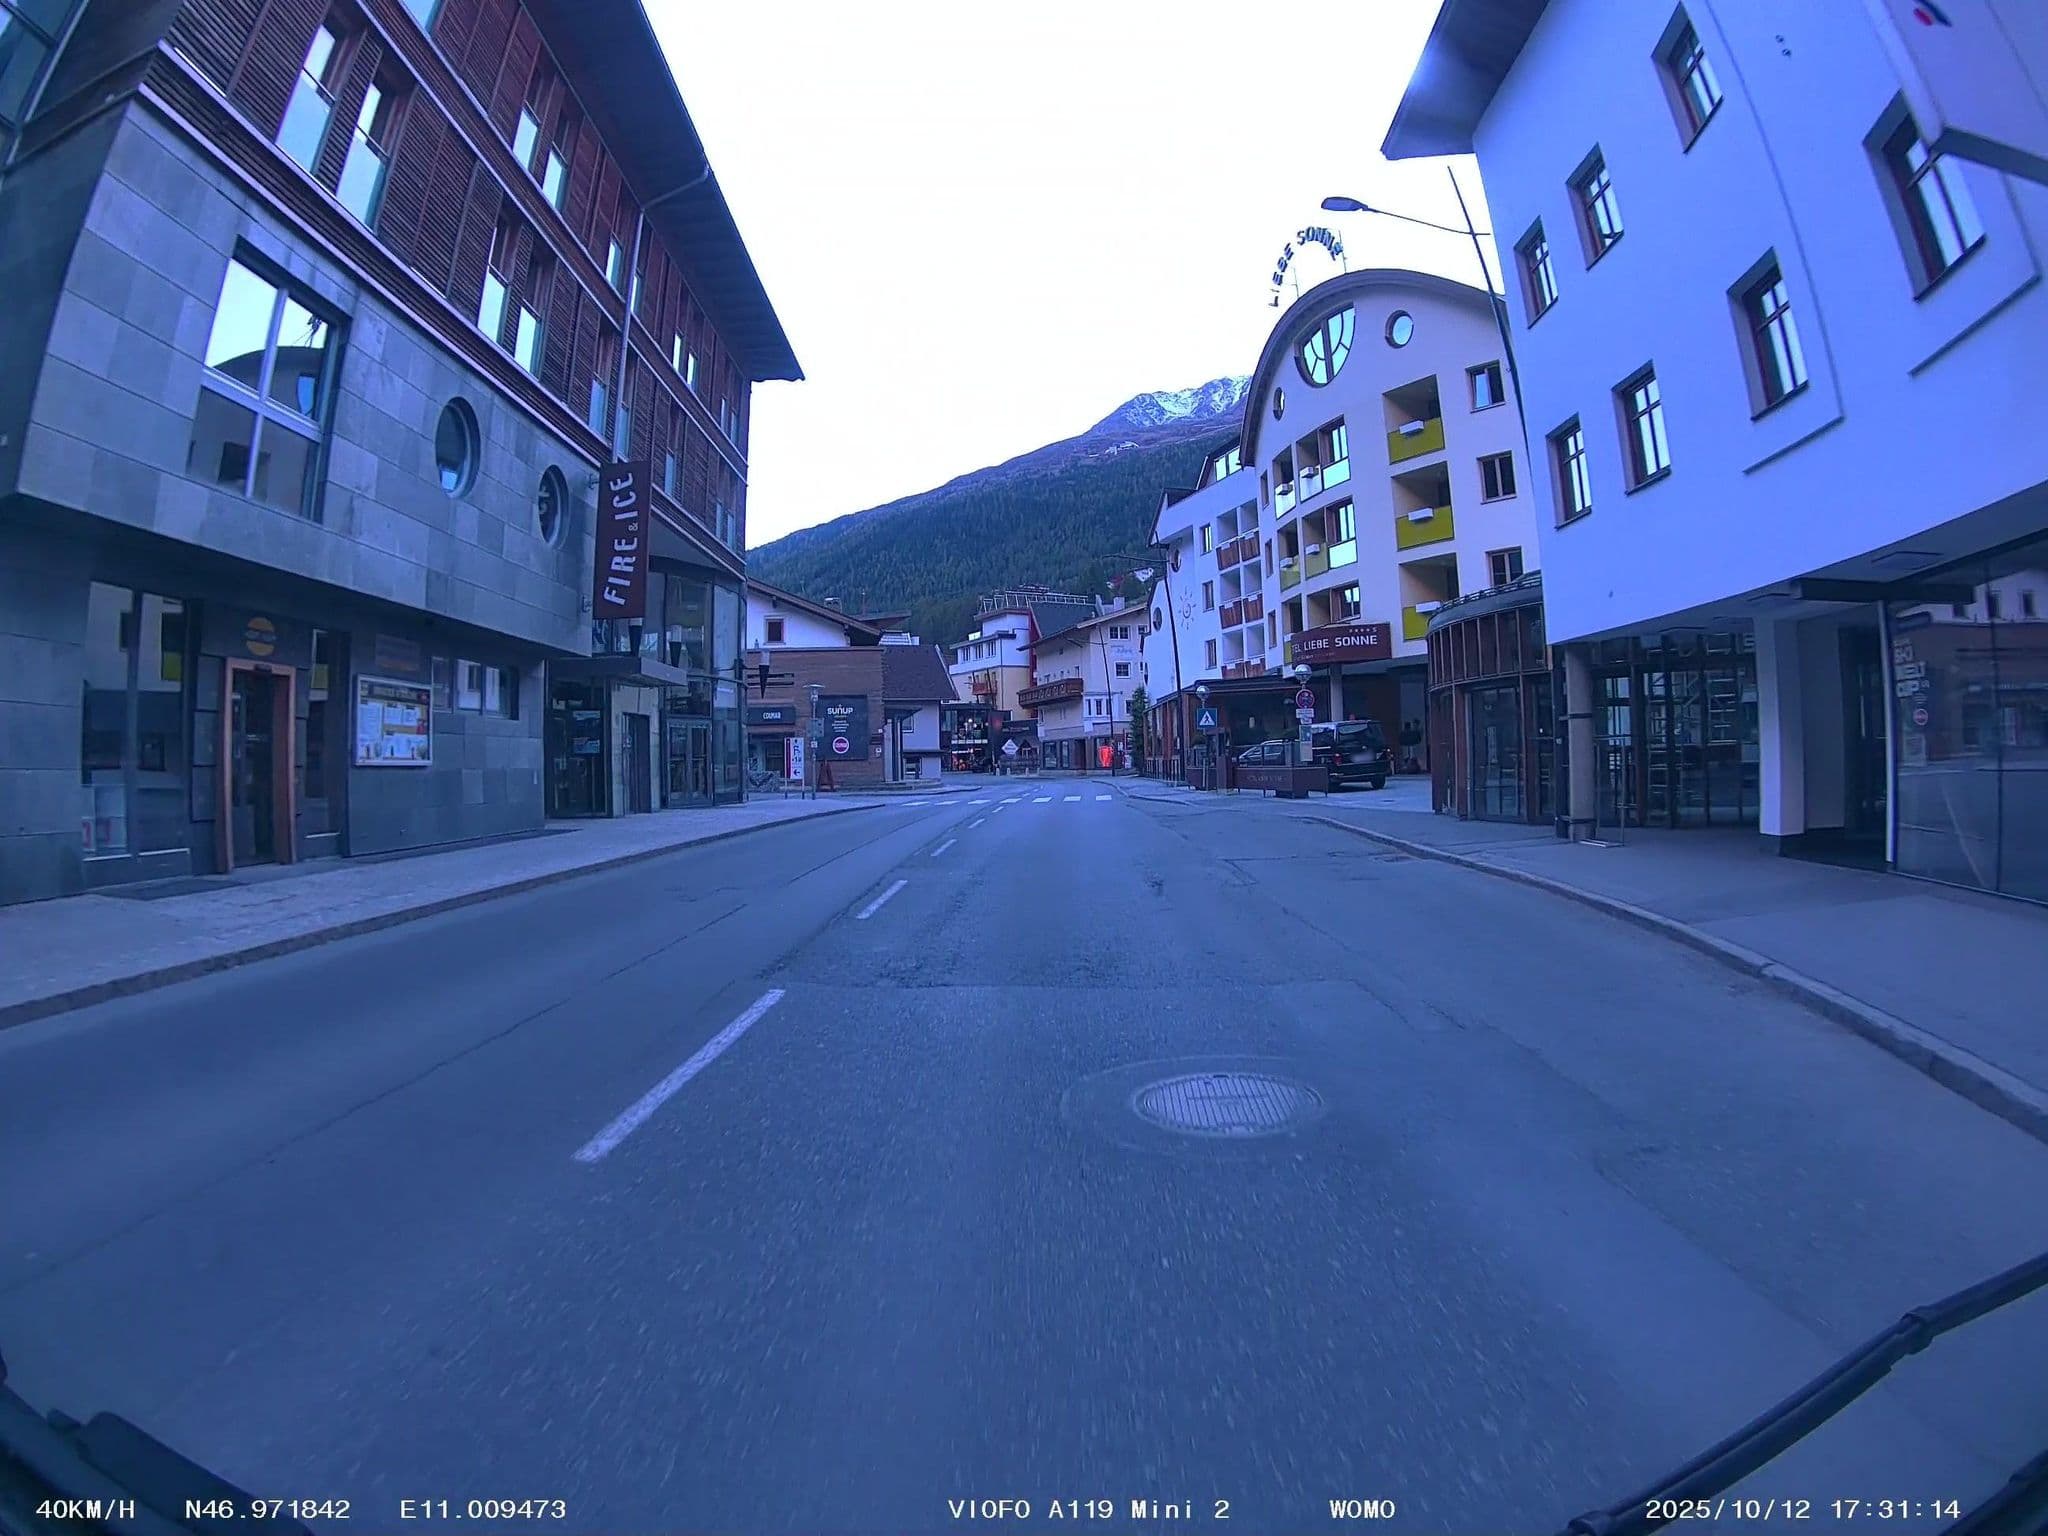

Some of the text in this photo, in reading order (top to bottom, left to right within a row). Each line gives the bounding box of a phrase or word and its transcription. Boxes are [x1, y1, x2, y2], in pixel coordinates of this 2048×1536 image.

[603, 472, 639, 606] FIRE & ICE
[1303, 638, 1330, 651] LIEBE
[1334, 635, 1378, 647] SONNE
